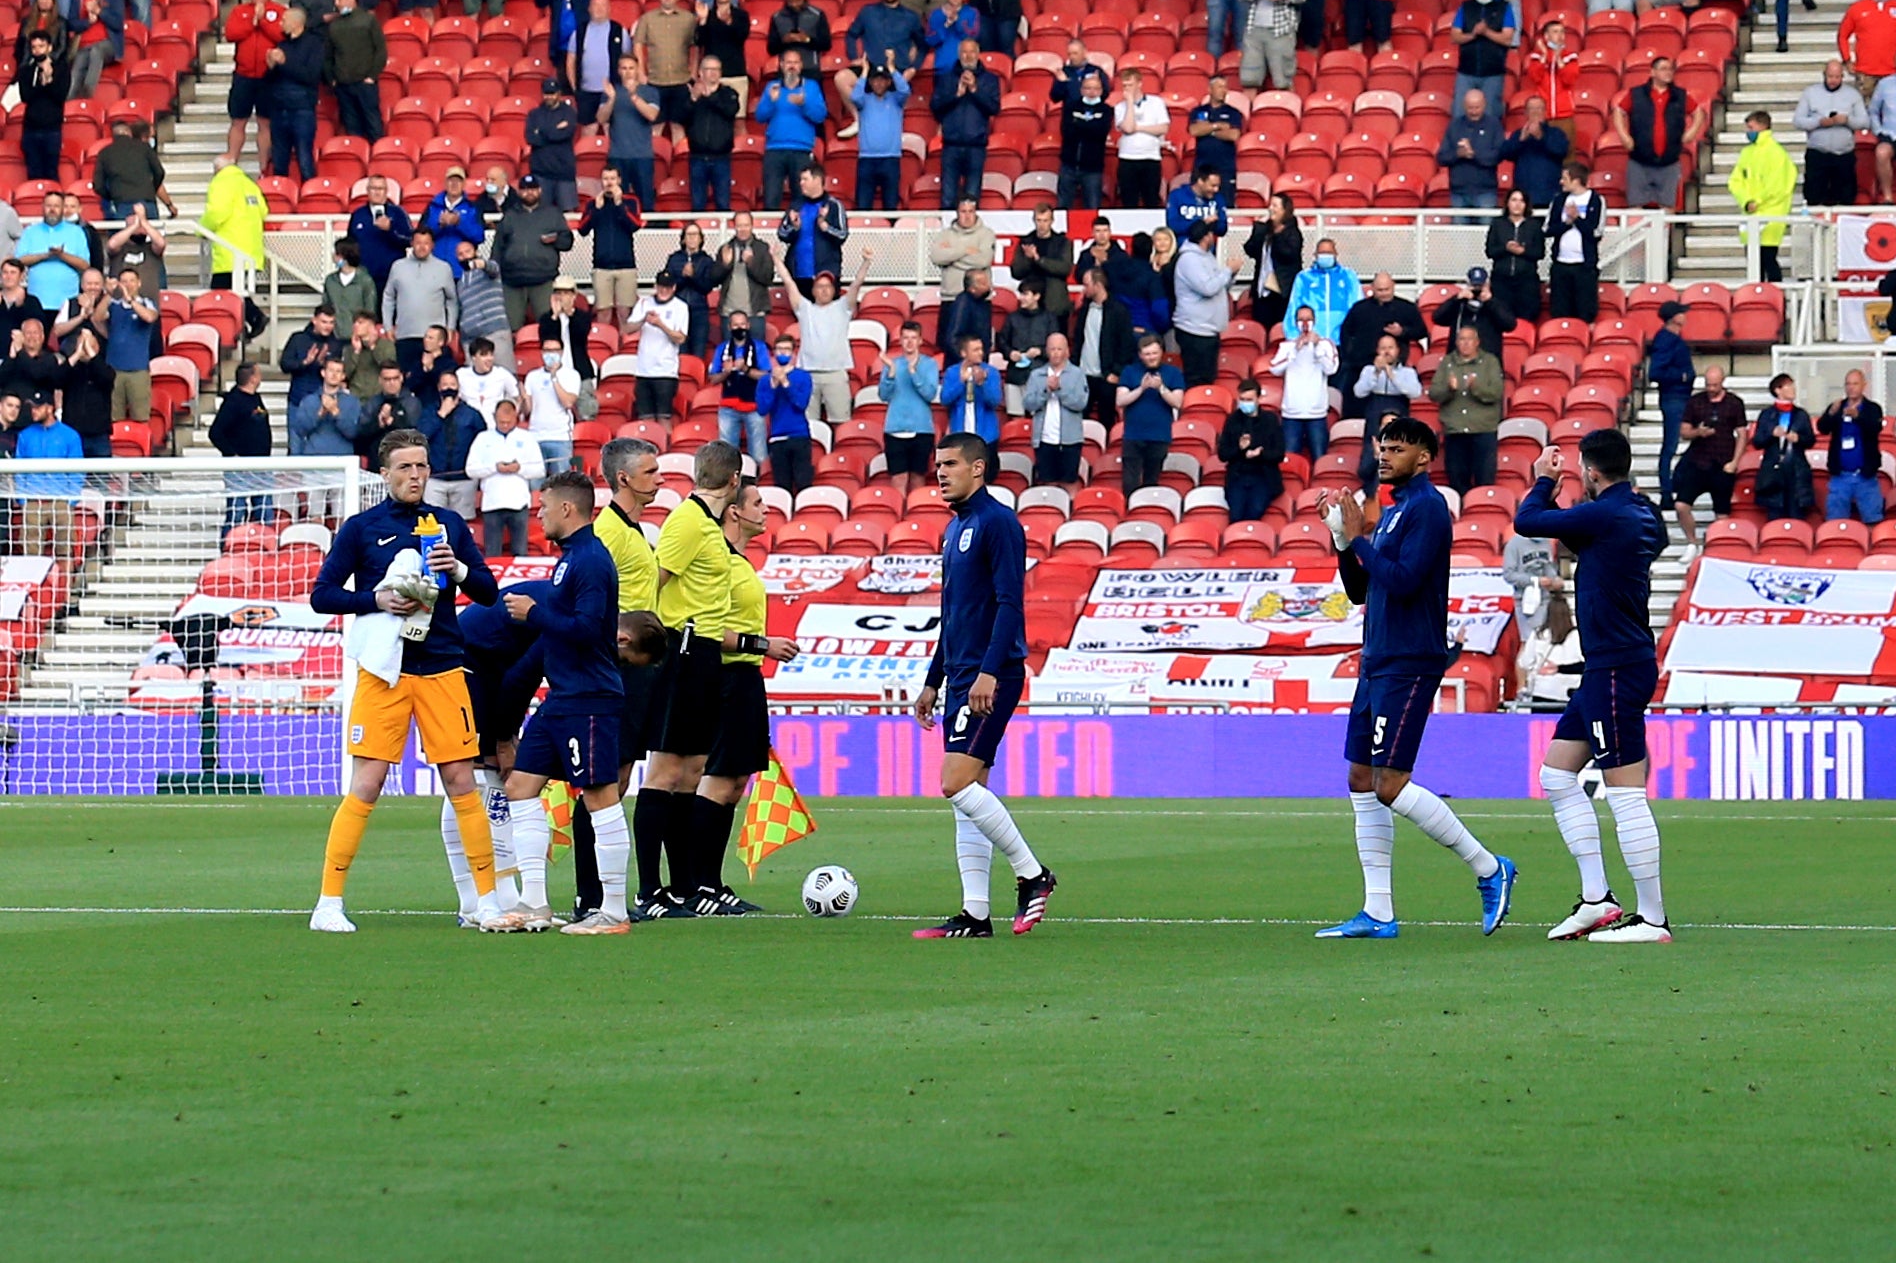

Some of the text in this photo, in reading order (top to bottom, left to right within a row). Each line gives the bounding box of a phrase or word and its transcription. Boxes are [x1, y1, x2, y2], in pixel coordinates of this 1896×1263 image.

[1110, 571, 1280, 583] FOWLER
[1103, 586, 1234, 598] BELL
[1094, 603, 1226, 617] BRISTOL
[1687, 607, 1793, 626] WEST
[405, 626, 423, 638] JP
[1077, 641, 1108, 650] ONE
[460, 706, 470, 733] 1
[954, 705, 972, 733] 6
[1373, 716, 1388, 746] 5
[1591, 720, 1607, 749] 4
[568, 737, 581, 767] 3
[1709, 719, 1865, 800] UNITED
